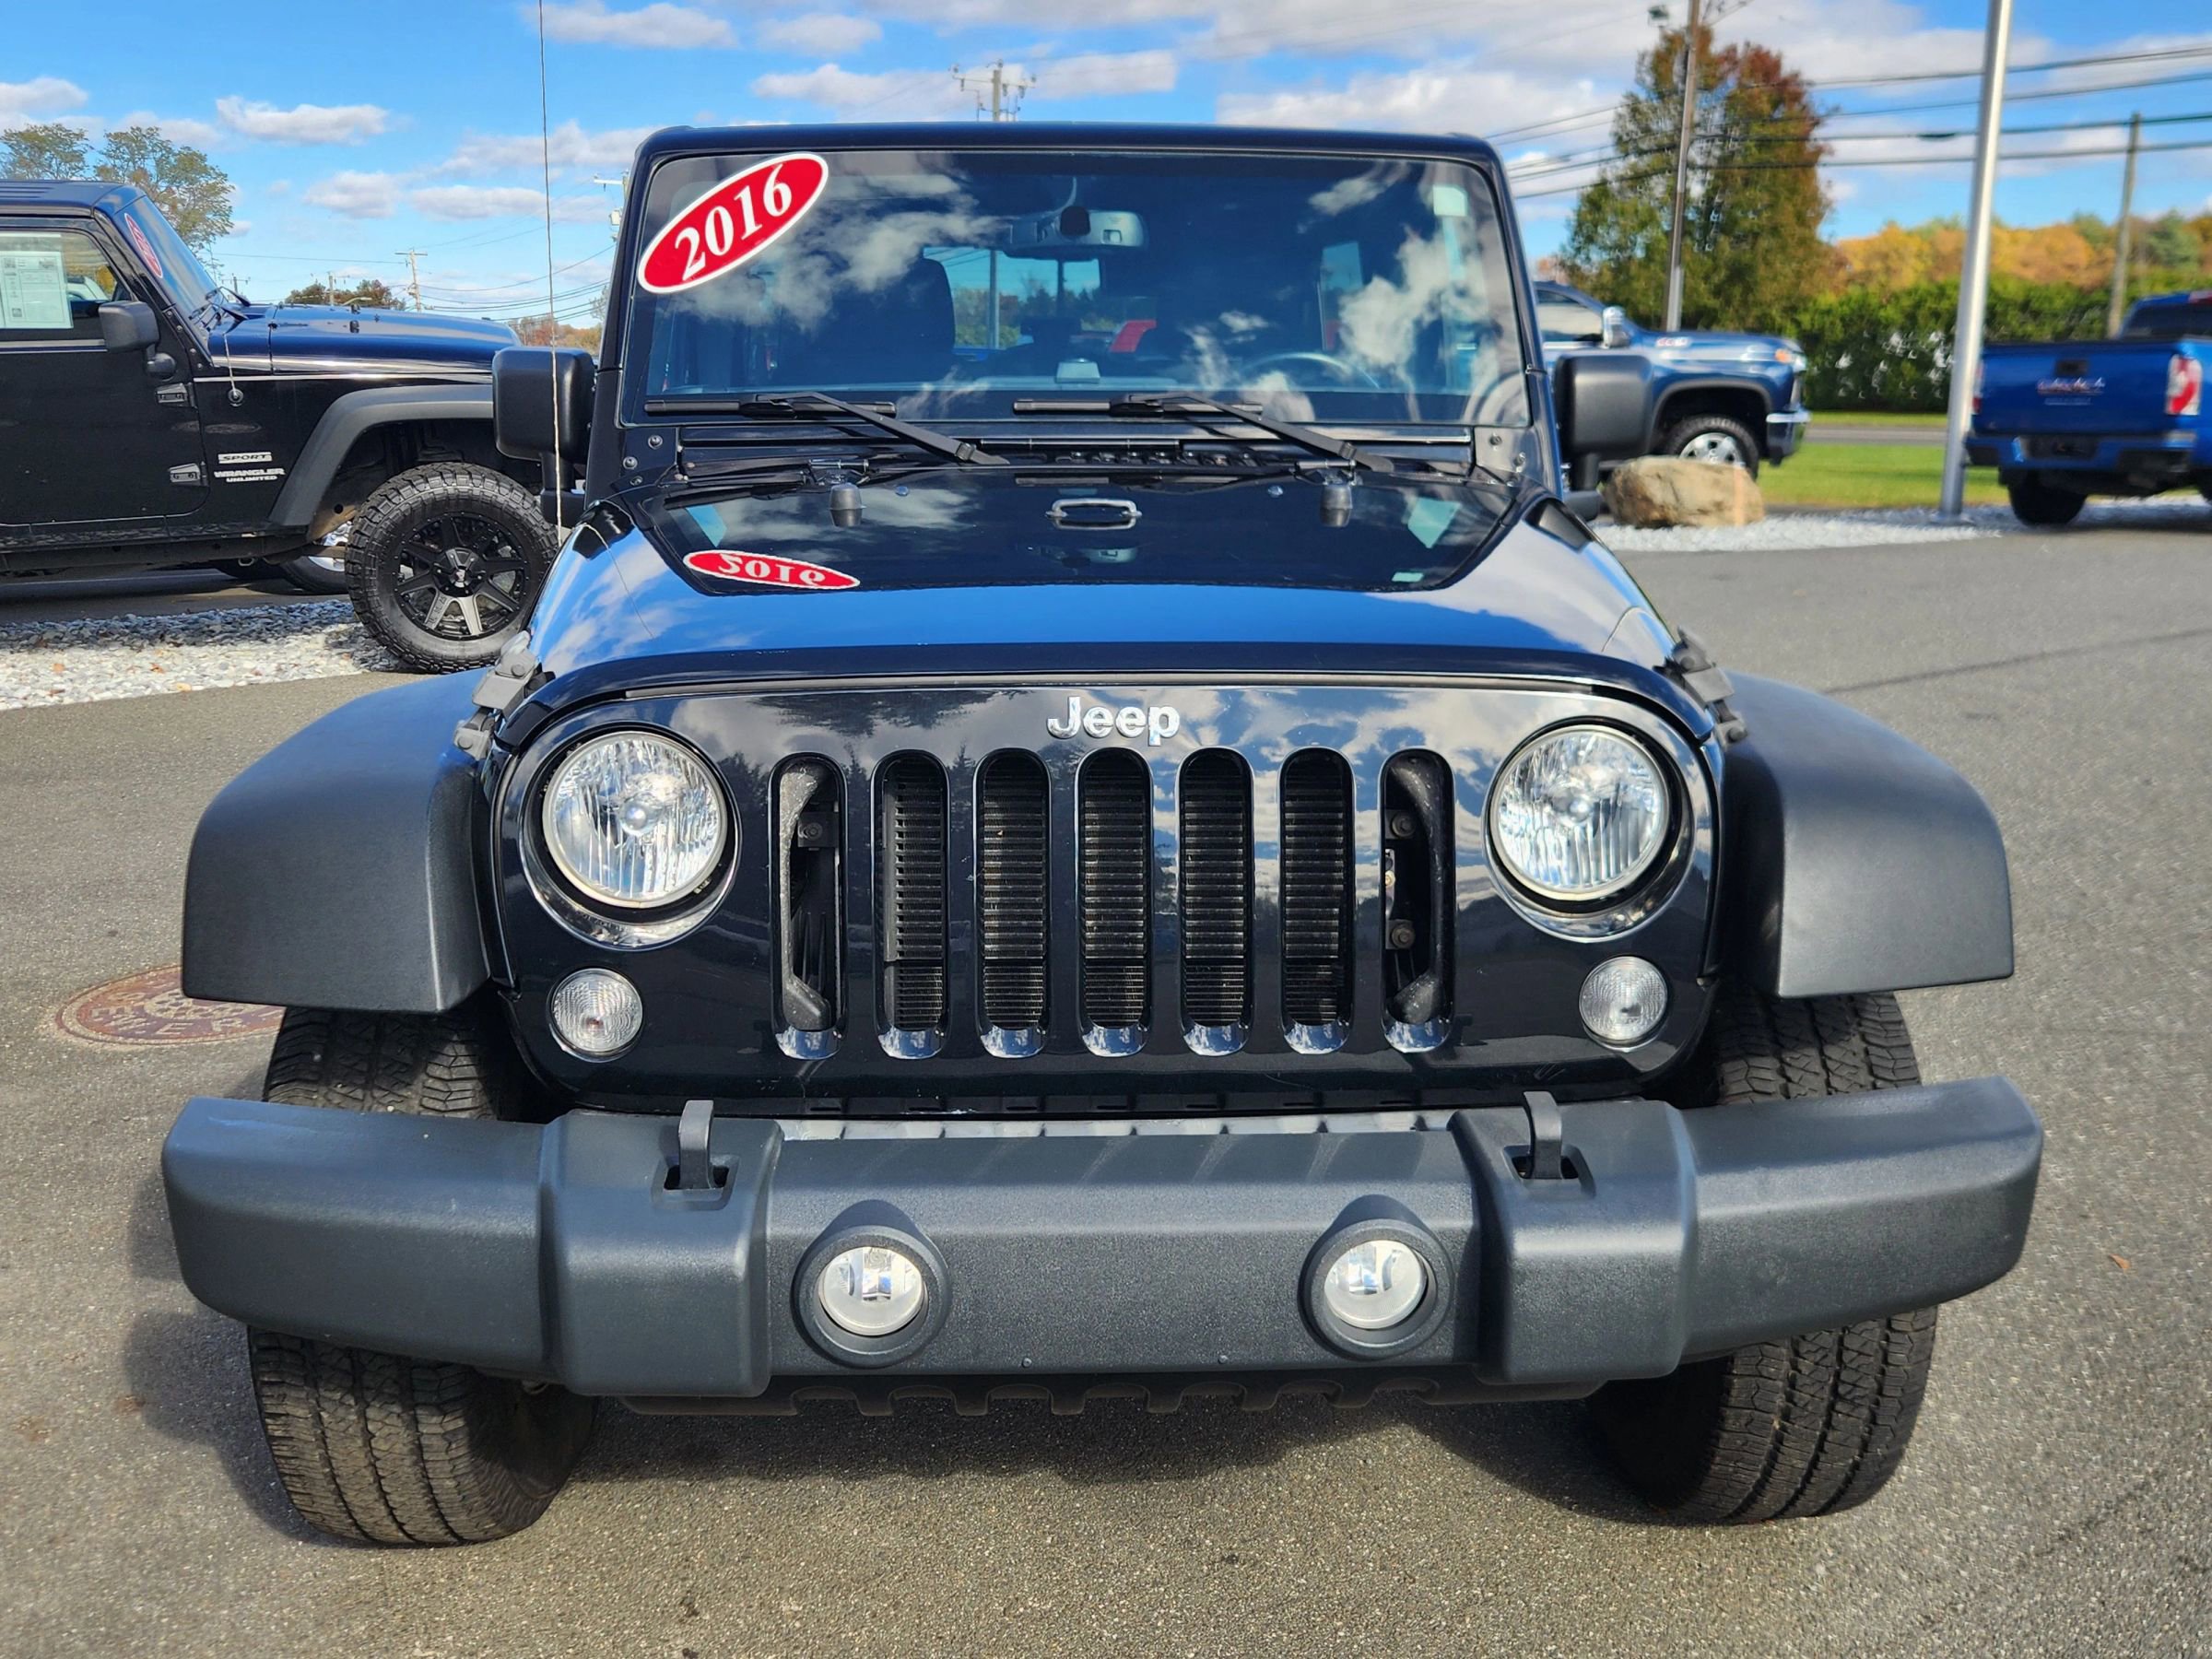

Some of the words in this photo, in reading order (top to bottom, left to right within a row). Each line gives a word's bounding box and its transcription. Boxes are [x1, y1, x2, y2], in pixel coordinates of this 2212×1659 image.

[675, 163, 793, 281] 2016
[213, 468, 287, 477] WRANGLER
[1047, 696, 1181, 747] Jeep
